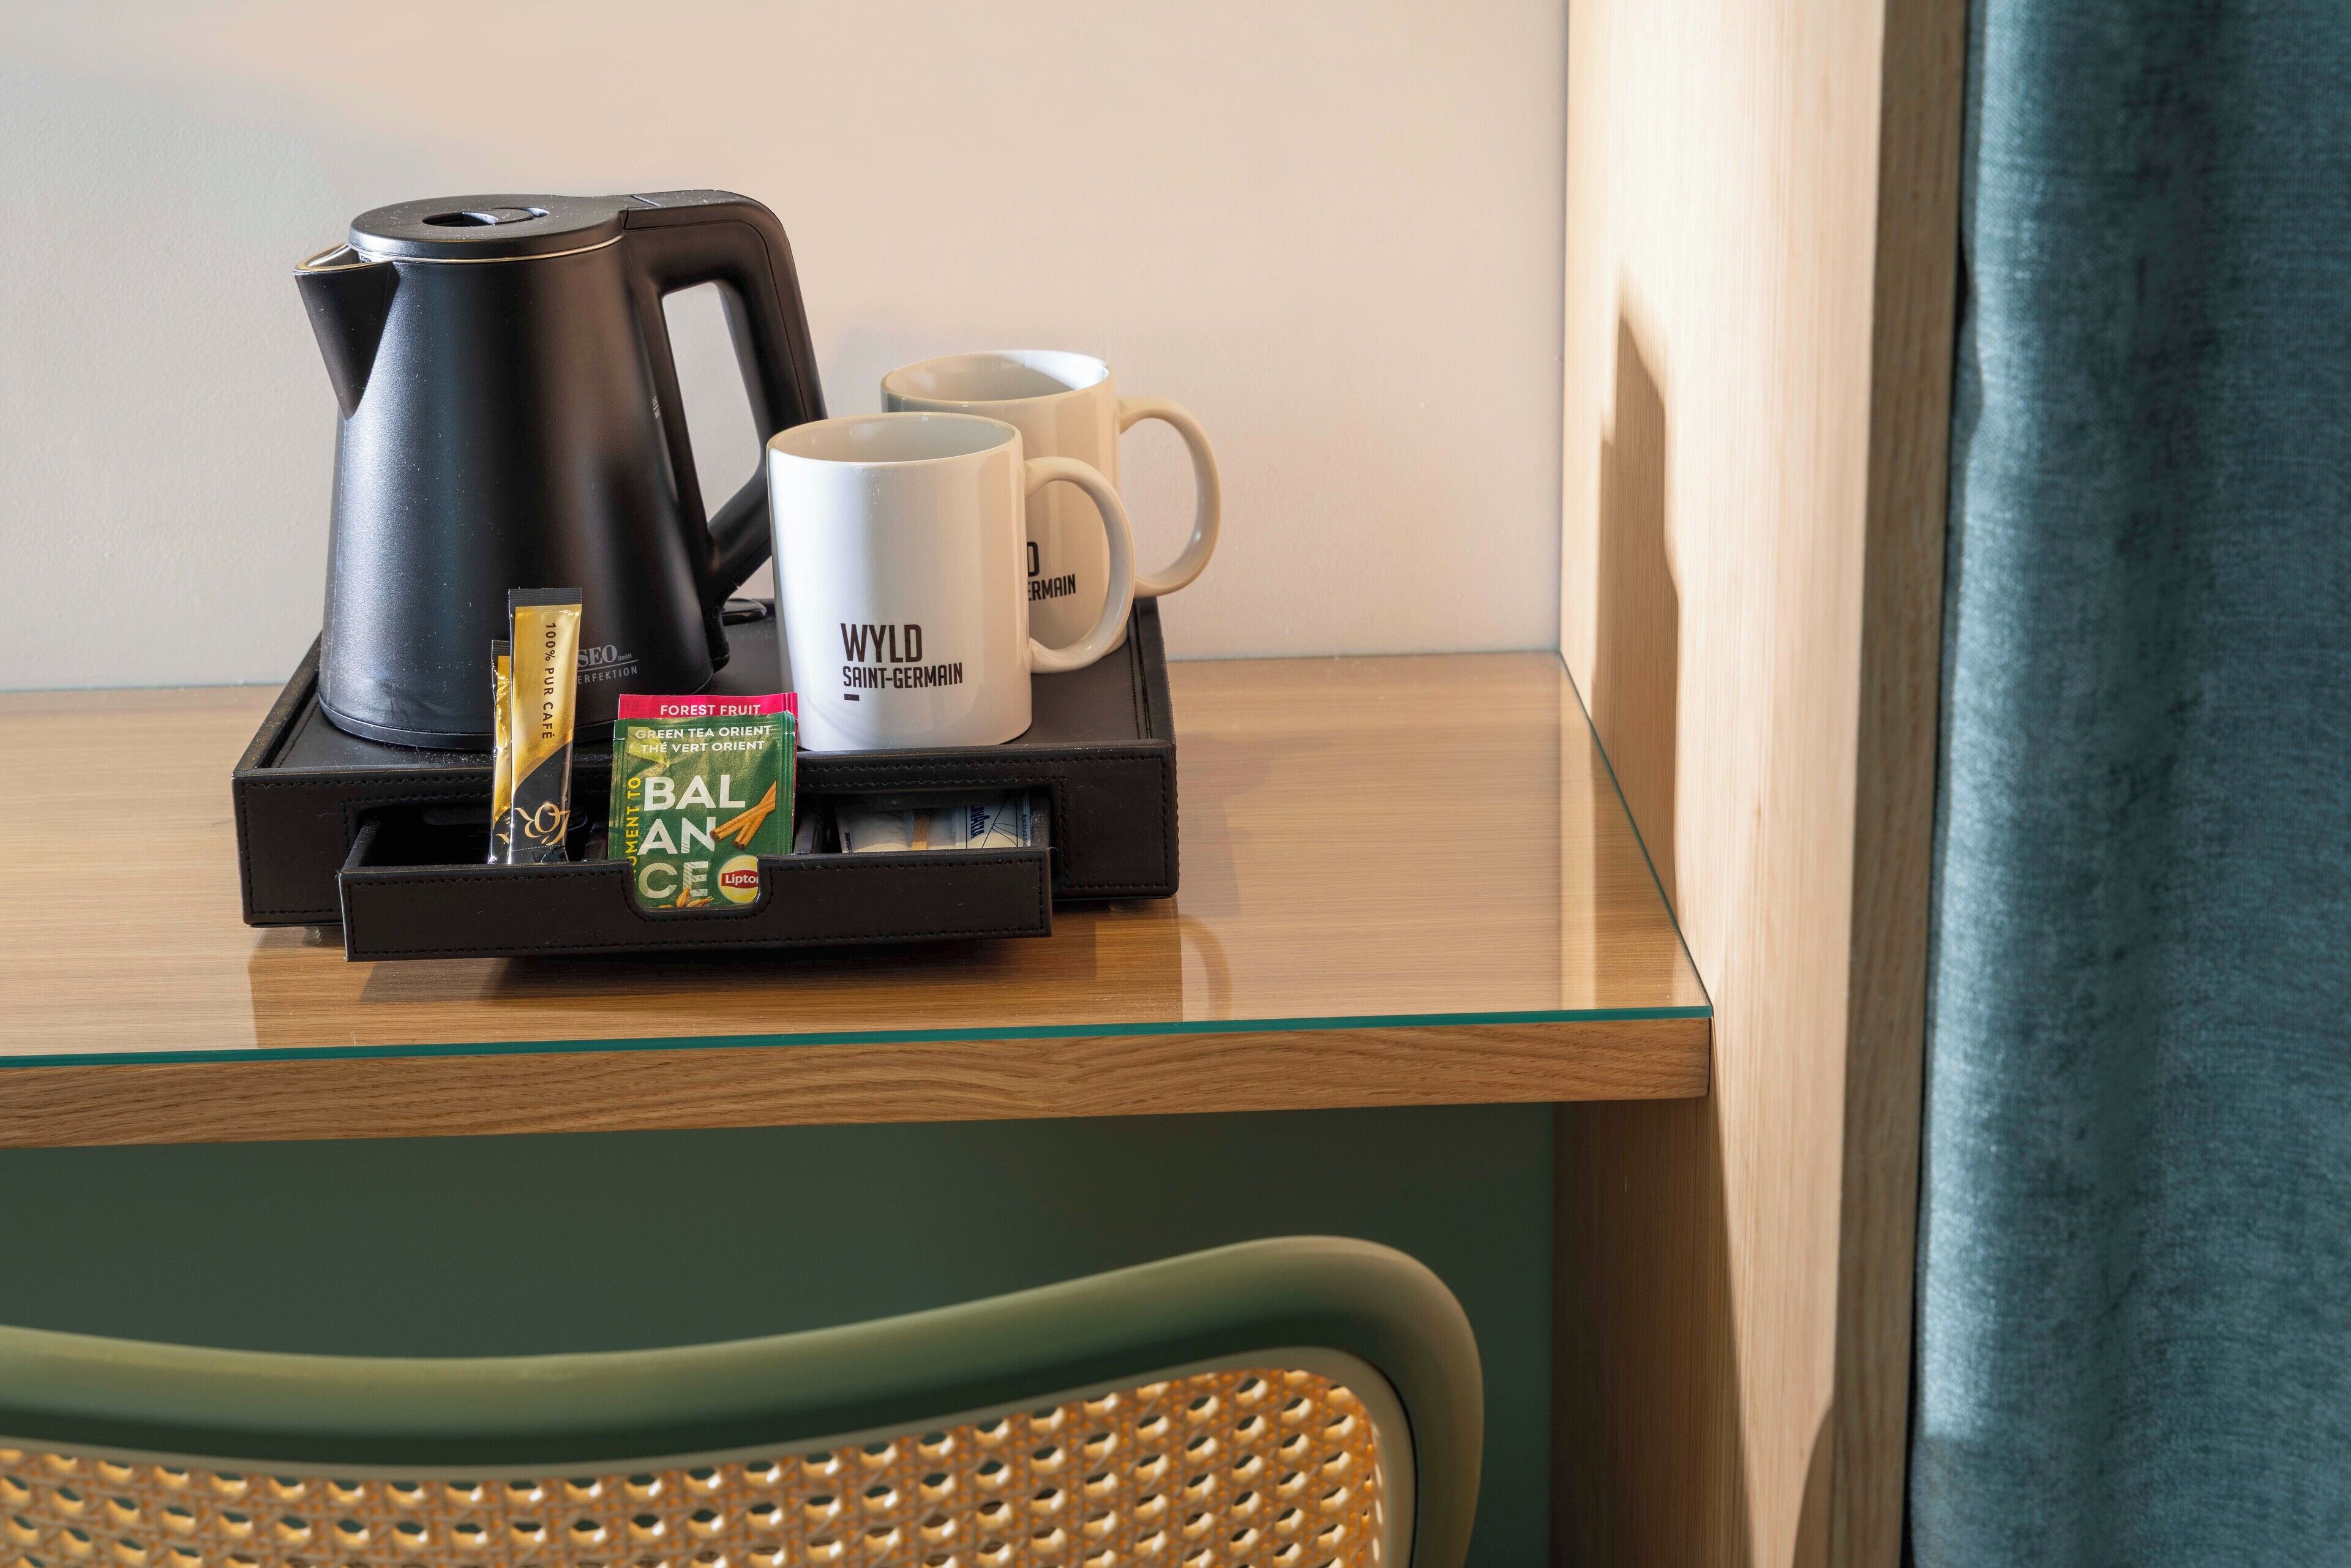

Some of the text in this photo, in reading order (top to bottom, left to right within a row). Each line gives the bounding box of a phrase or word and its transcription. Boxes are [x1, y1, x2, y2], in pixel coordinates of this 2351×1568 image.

[841, 623, 923, 662] WYLD
[578, 645, 632, 667] SEO GmbH
[542, 623, 557, 739] 100% PUR CAFÉ
[577, 666, 637, 685] ERFEKTION
[843, 662, 962, 689] SAINT-GERMAIN
[661, 704, 761, 715] FOREST FRUIT
[636, 725, 772, 740] GREEN TEA ORIENT
[641, 740, 765, 753] THÉ VERT ORIENT
[627, 776, 642, 800] TO
[643, 774, 746, 811] BAL
[637, 816, 716, 855] AN
[639, 861, 709, 899] CE
[725, 874, 758, 885] Lipto
